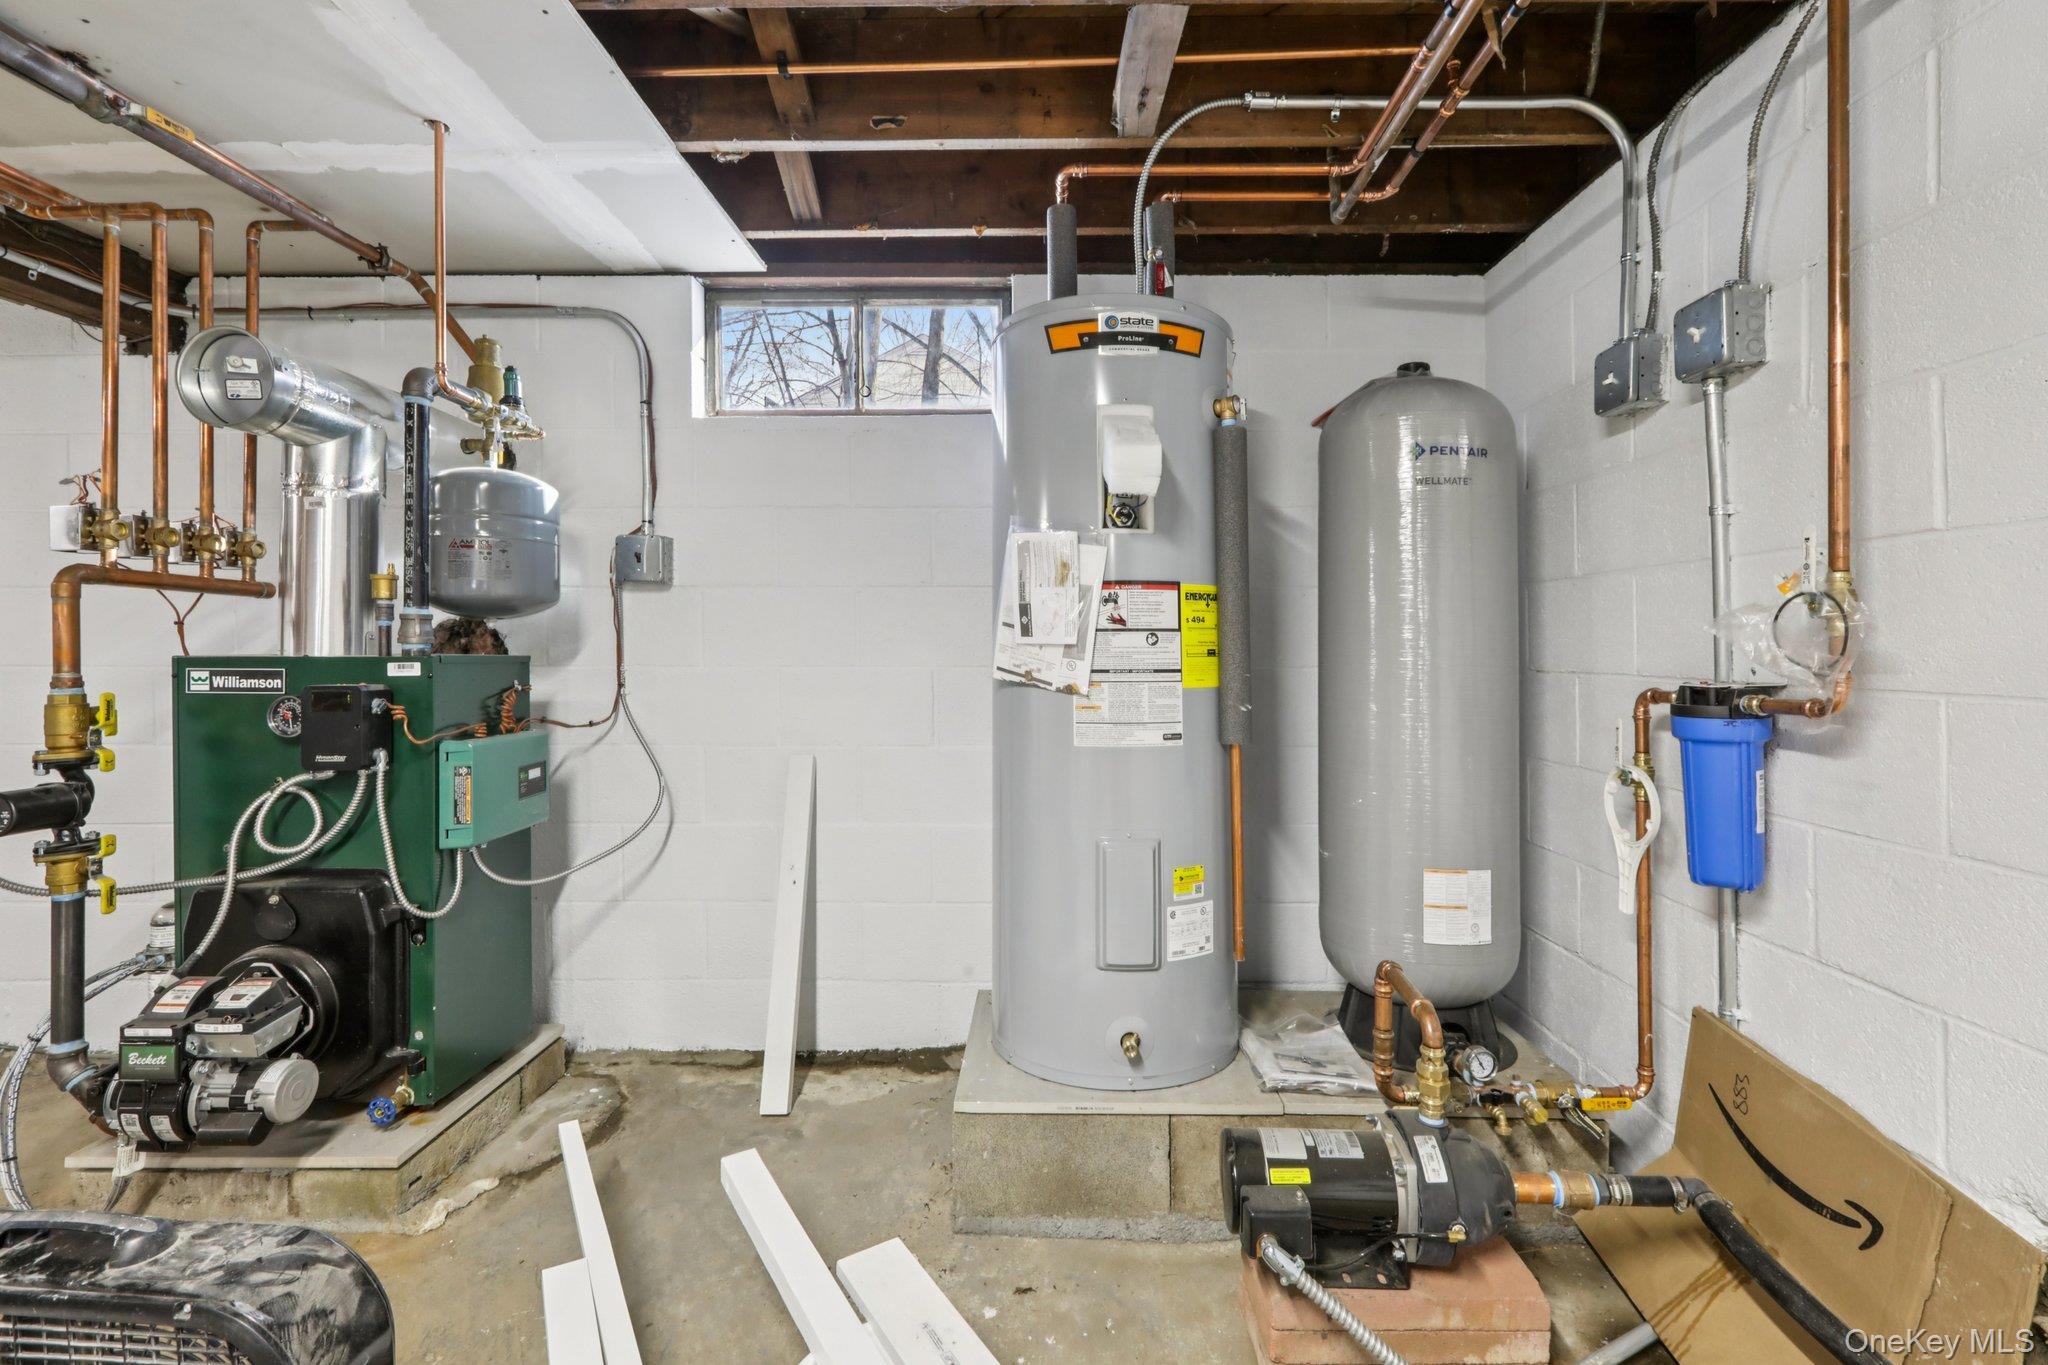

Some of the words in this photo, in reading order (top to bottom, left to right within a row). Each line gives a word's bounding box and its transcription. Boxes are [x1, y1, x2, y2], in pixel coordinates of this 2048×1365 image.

[1120, 317, 1154, 327] state
[1430, 446, 1488, 458] PENTAIR
[1191, 616, 1206, 624] 494
[212, 675, 282, 689] Williamson
[128, 1052, 168, 1065] Beckett
